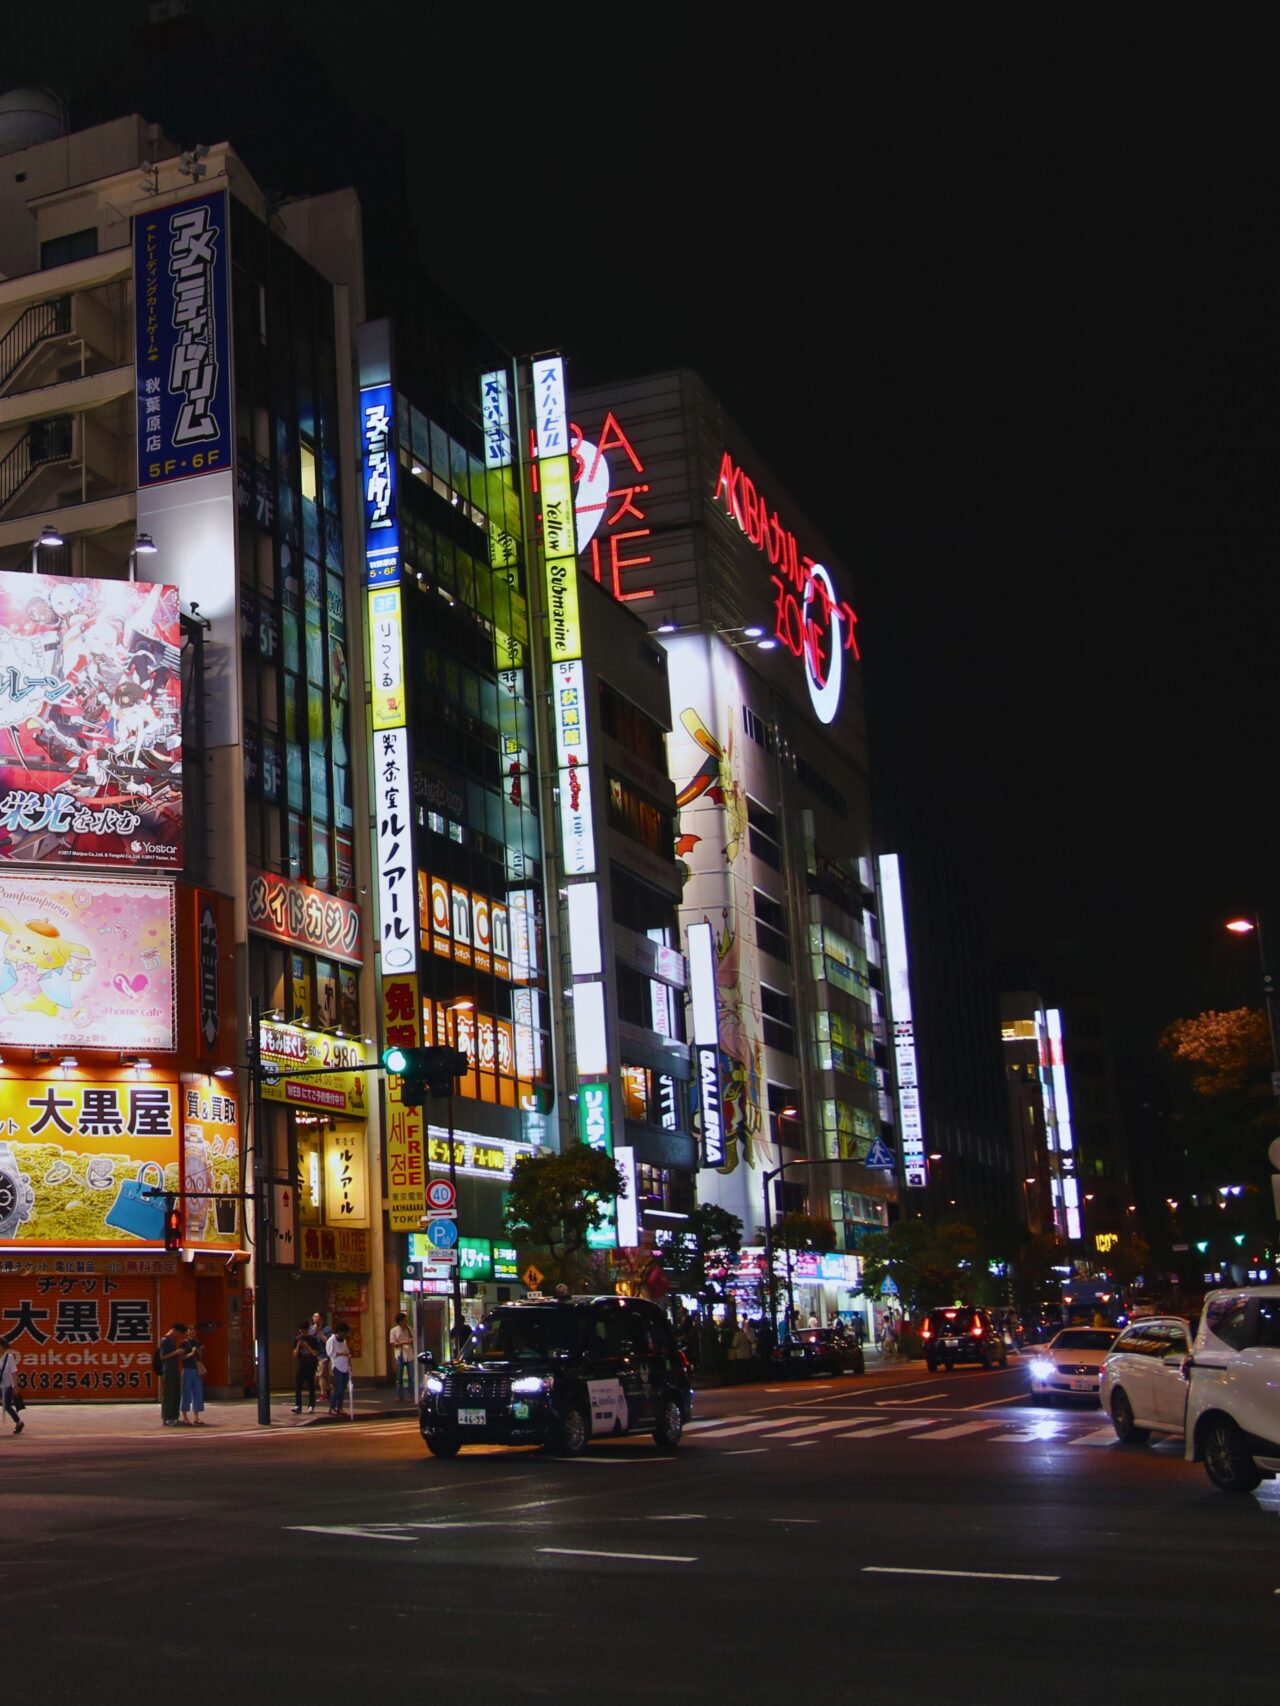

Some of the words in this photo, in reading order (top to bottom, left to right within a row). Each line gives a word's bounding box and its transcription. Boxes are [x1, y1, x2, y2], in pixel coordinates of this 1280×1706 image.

[145, 376, 162, 454] 秋葉原店
[546, 500, 564, 552] Yellow
[377, 595, 395, 610] 3F
[550, 565, 570, 652] Submarine
[771, 574, 827, 688] ZONE
[559, 662, 576, 675] 5F
[382, 733, 401, 809] 喫茶室
[142, 841, 178, 854] Yostar
[381, 812, 410, 941] ルノアール
[248, 876, 359, 953] メイドカジノ
[27, 1086, 173, 1138] 大黒屋
[699, 1049, 722, 1164] GALLERIA
[340, 1149, 355, 1215] ルノアール
[433, 1187, 449, 1201] 40
[434, 1226, 446, 1245] P
[37, 1275, 119, 1295] チケット
[1, 1299, 154, 1345] 大黒屋
